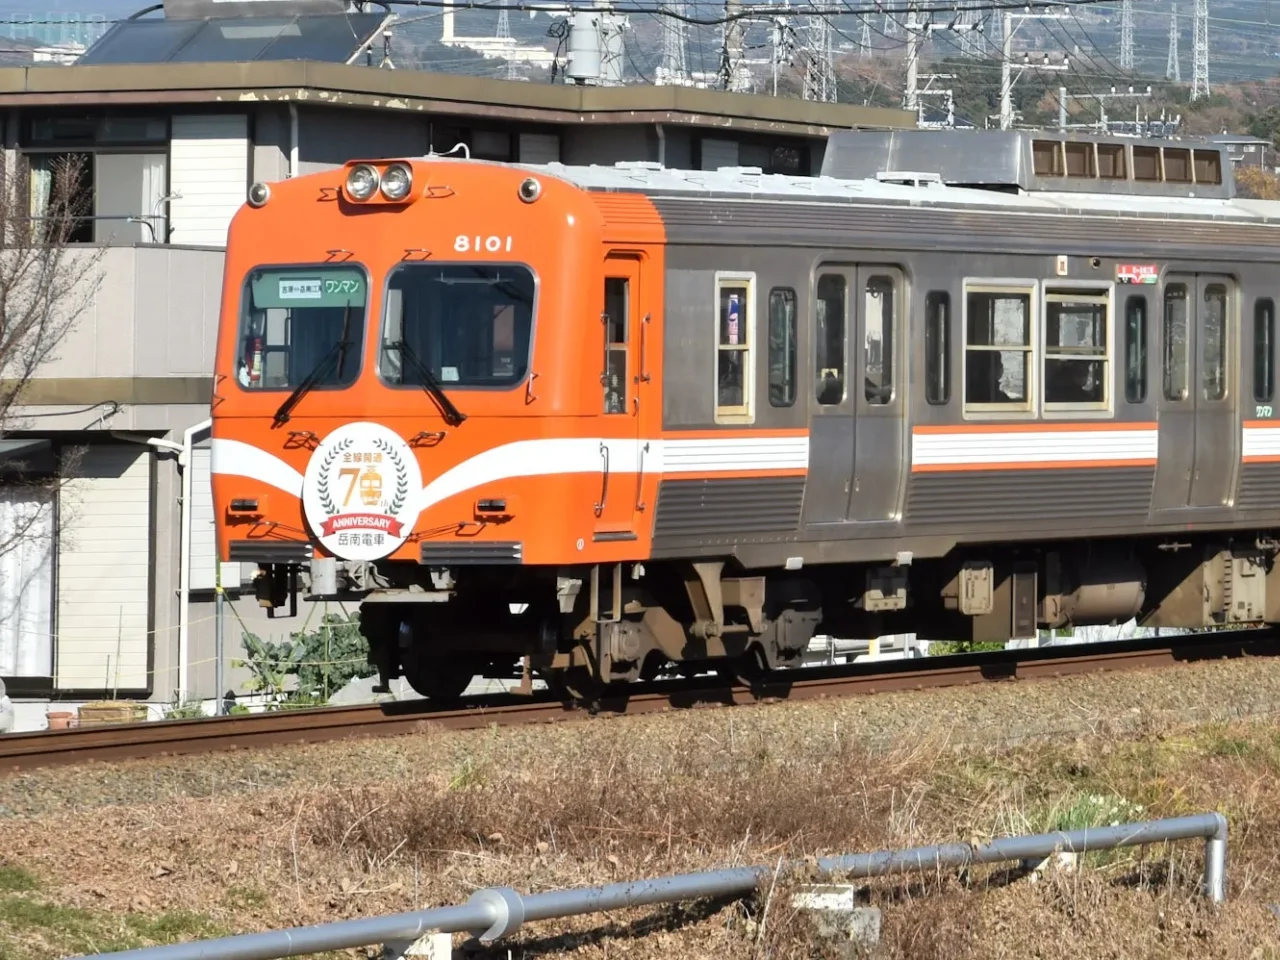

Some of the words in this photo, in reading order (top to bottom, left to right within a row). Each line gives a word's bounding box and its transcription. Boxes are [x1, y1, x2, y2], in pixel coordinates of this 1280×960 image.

[454, 235, 513, 252] 8101
[325, 280, 359, 293] ワンマン
[343, 452, 383, 463] 全線開通
[332, 516, 391, 528] ANNIVERSARY
[338, 533, 385, 546] 岳南電車
